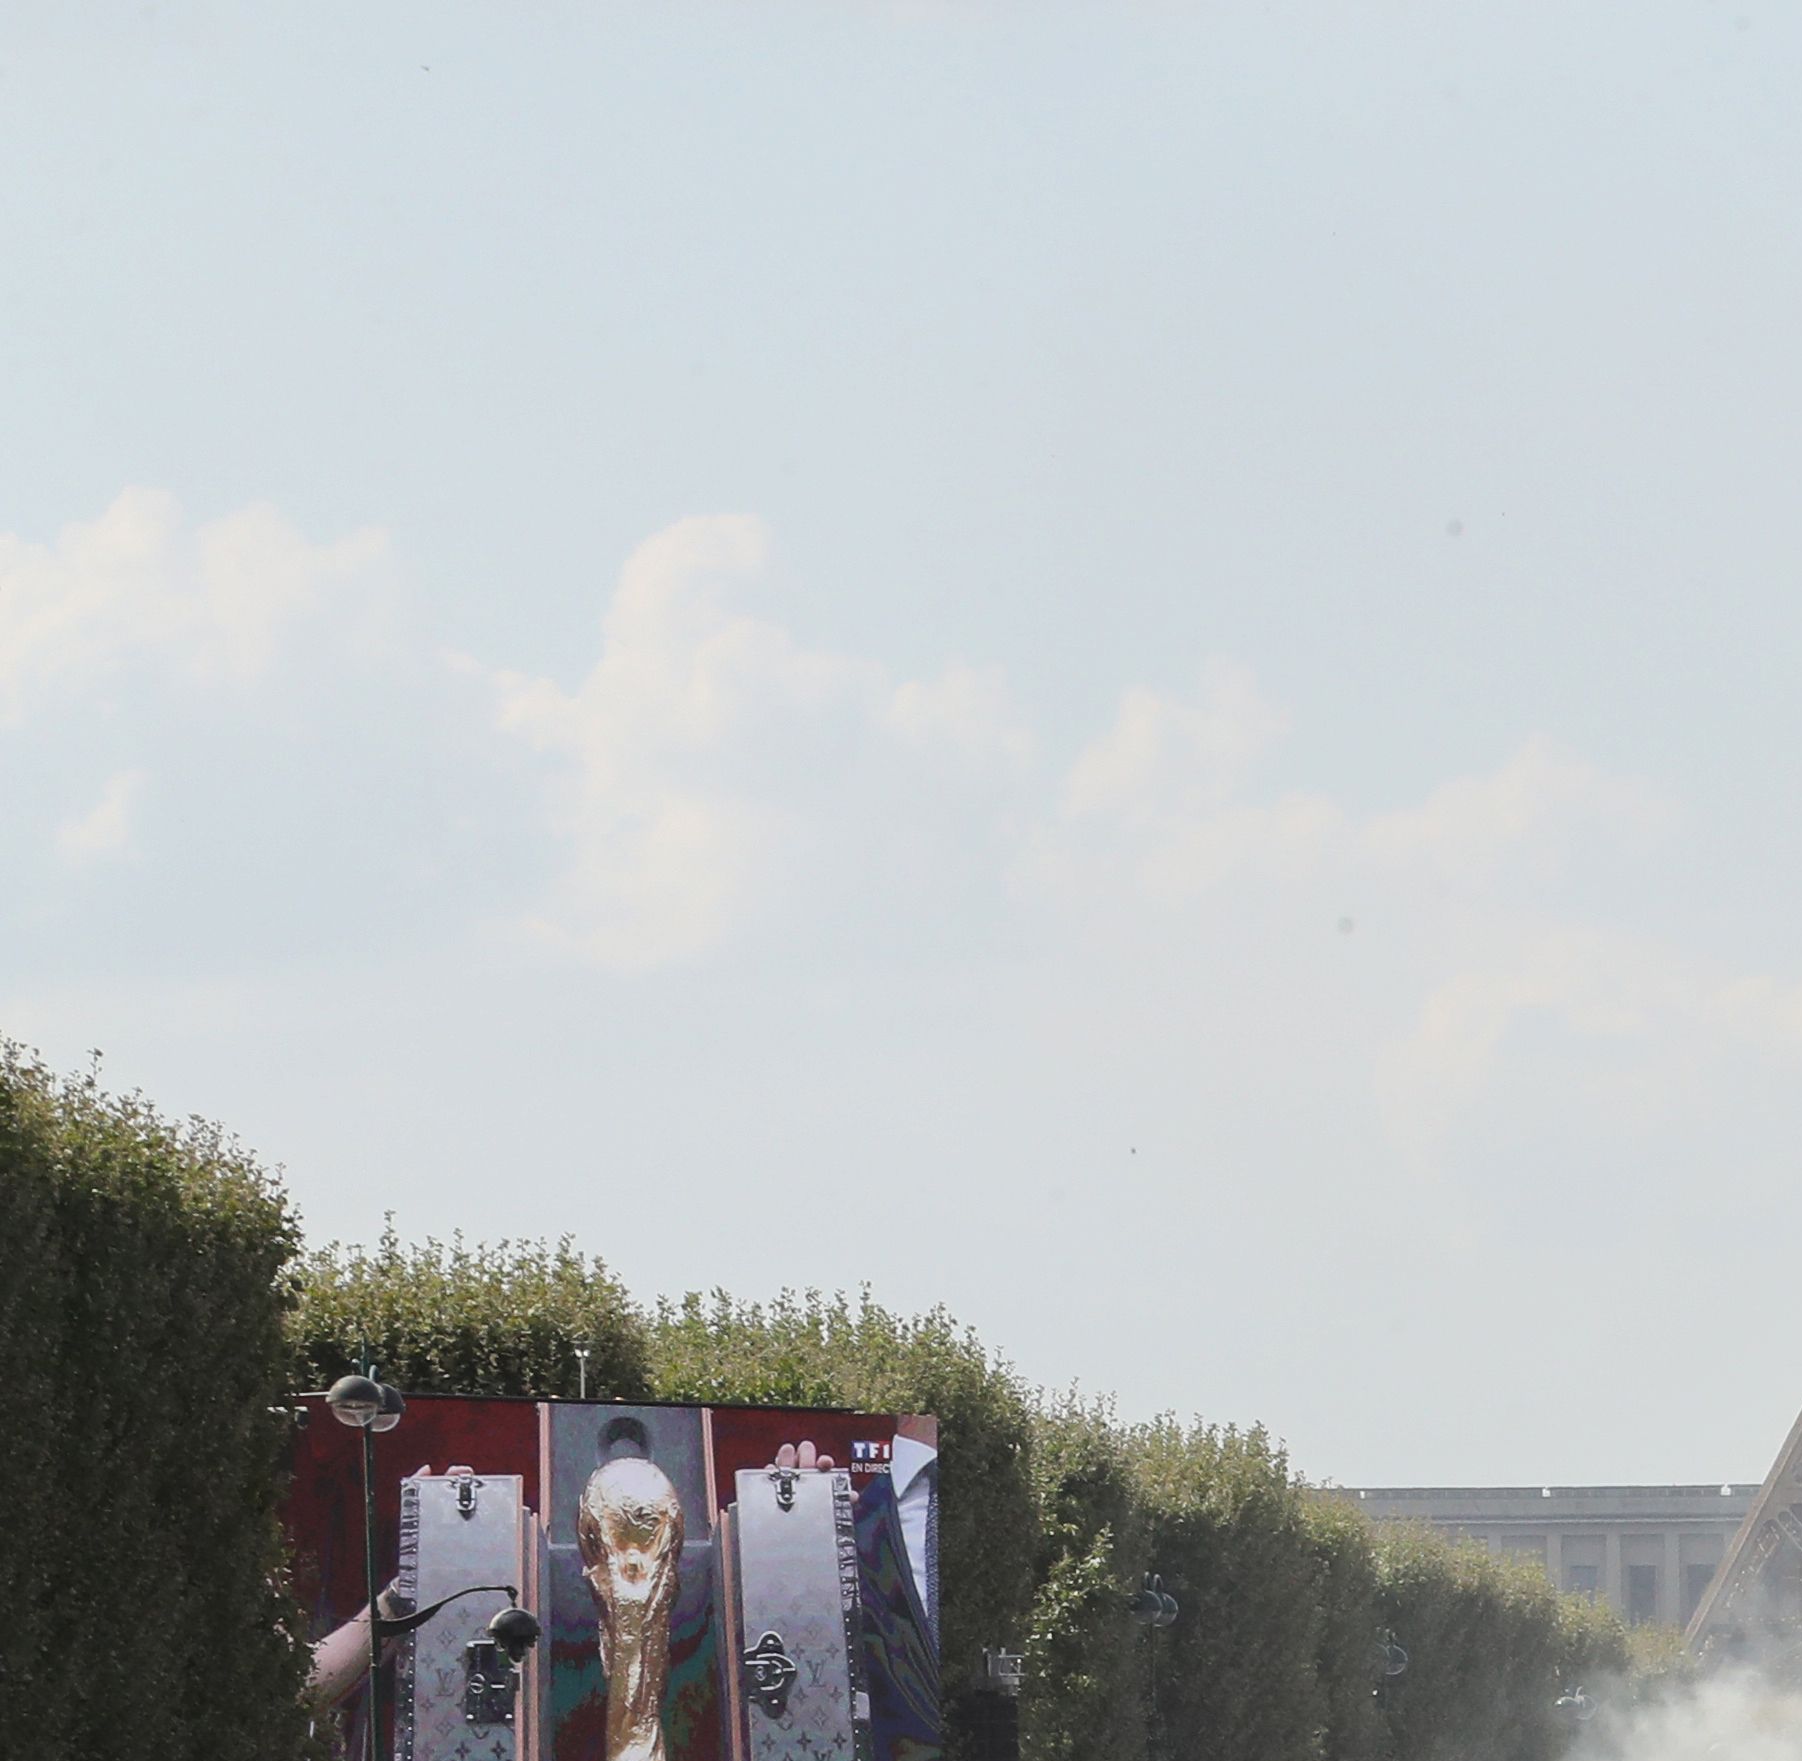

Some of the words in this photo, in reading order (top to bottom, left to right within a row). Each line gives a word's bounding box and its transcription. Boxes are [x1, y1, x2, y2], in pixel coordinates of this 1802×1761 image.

[853, 1442, 890, 1459] TF1
[851, 1462, 863, 1473] EN
[864, 1462, 892, 1473] DIREC
